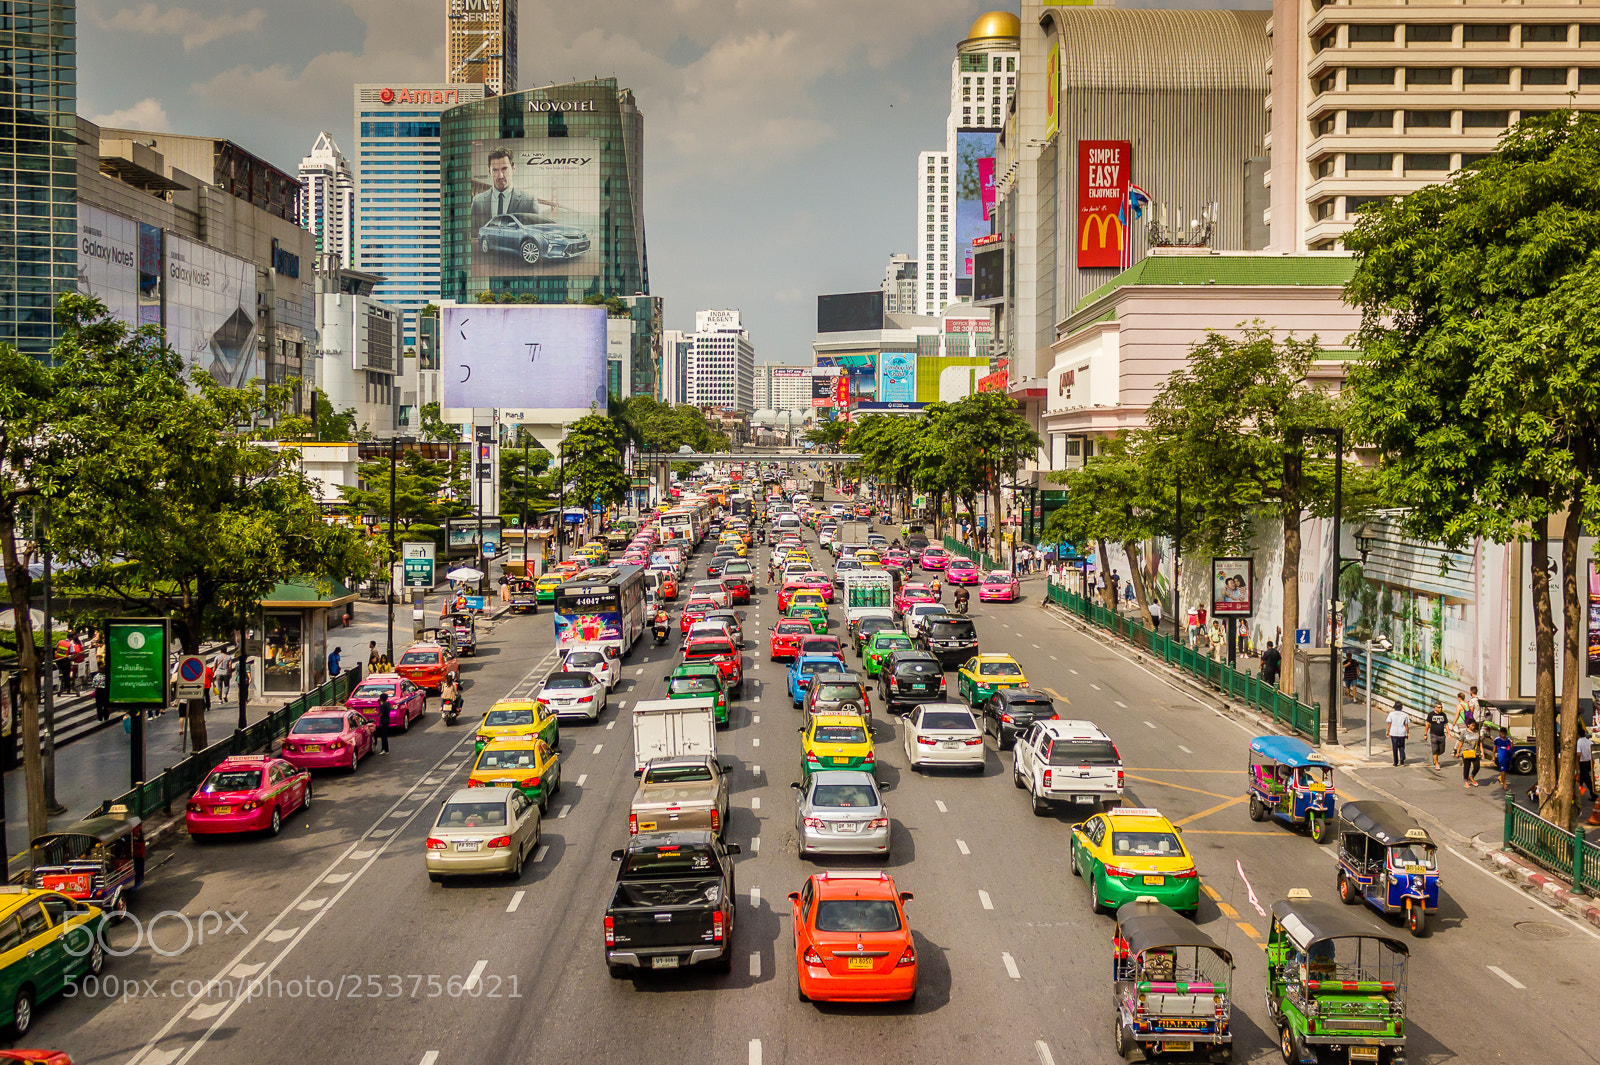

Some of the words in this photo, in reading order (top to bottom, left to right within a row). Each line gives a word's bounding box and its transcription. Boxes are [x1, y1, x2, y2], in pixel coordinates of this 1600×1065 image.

[397, 88, 459, 104] Amari
[528, 100, 598, 112] NOVOTEL
[526, 157, 592, 166] CAMRY
[1089, 149, 1120, 164] SIMPLE
[1089, 165, 1120, 187] EASY
[1088, 188, 1120, 198] ENJOYMENT
[82, 237, 111, 265] Galaxy
[111, 246, 134, 268] Note5
[169, 262, 192, 286] Galaxy
[192, 268, 210, 287] Note5
[1157, 1020, 1208, 1029] THAILAND
